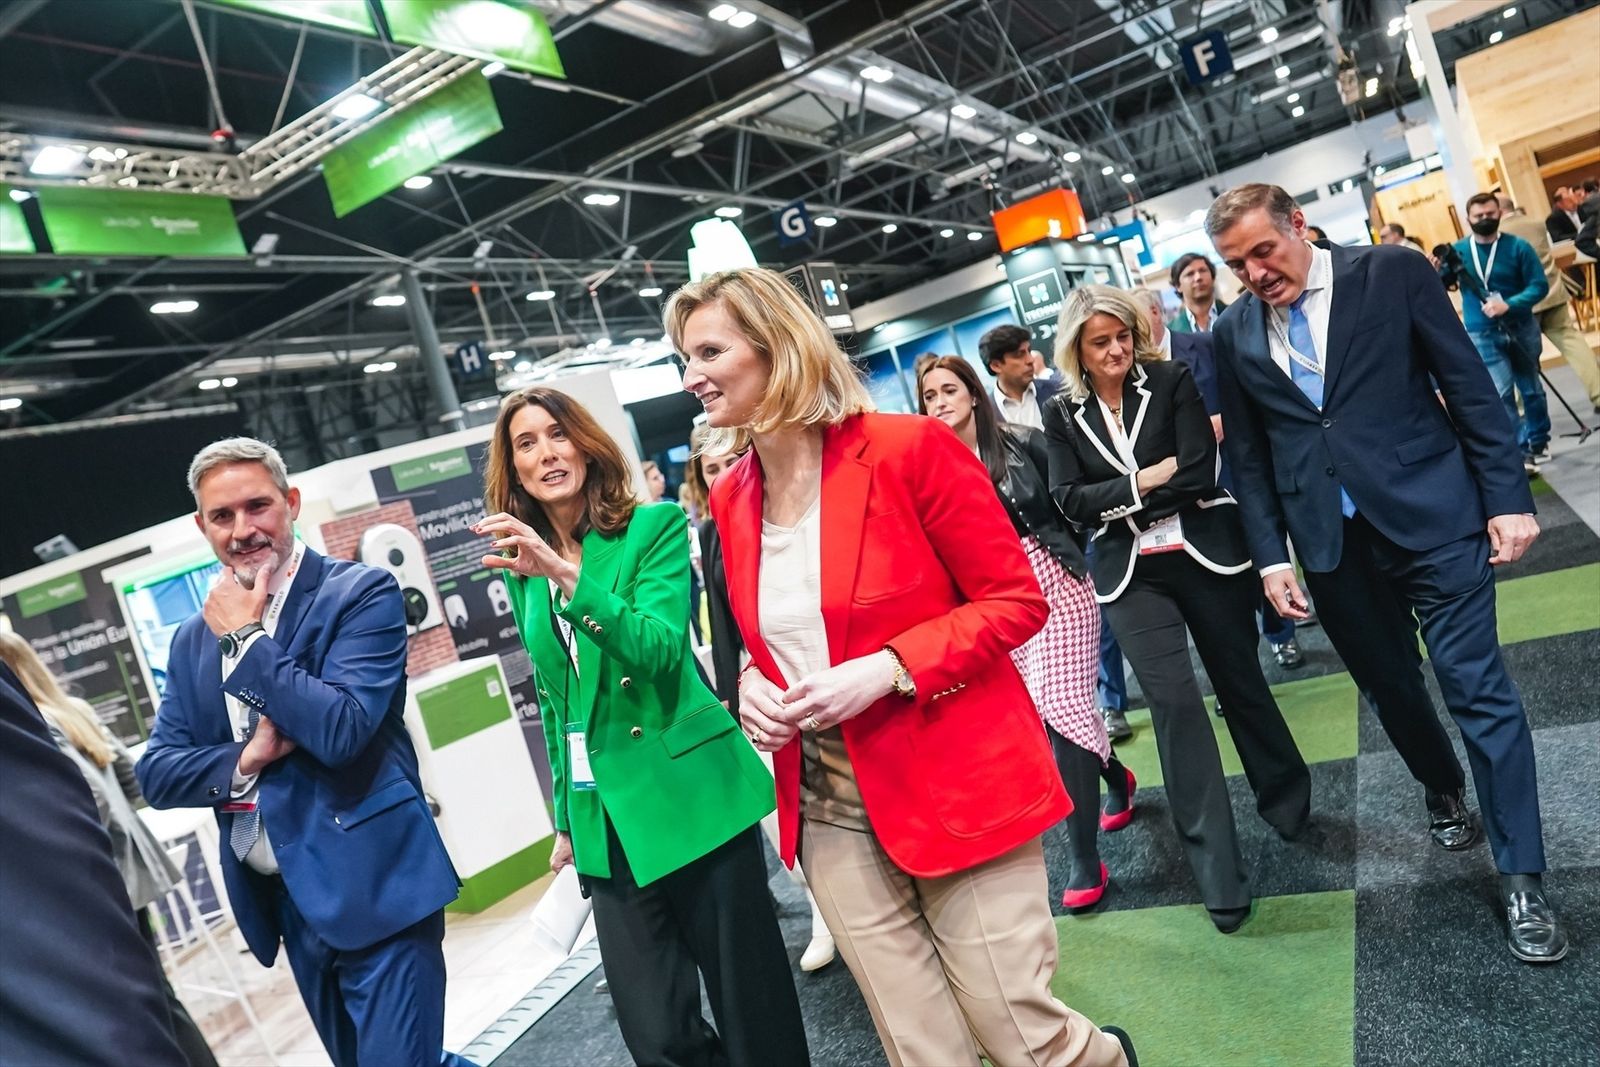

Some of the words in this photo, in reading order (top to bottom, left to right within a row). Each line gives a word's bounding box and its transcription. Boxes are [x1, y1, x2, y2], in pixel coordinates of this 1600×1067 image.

[1192, 39, 1215, 77] F
[780, 207, 806, 237] G
[460, 345, 481, 374] H
[66, 632, 109, 656] Unión
